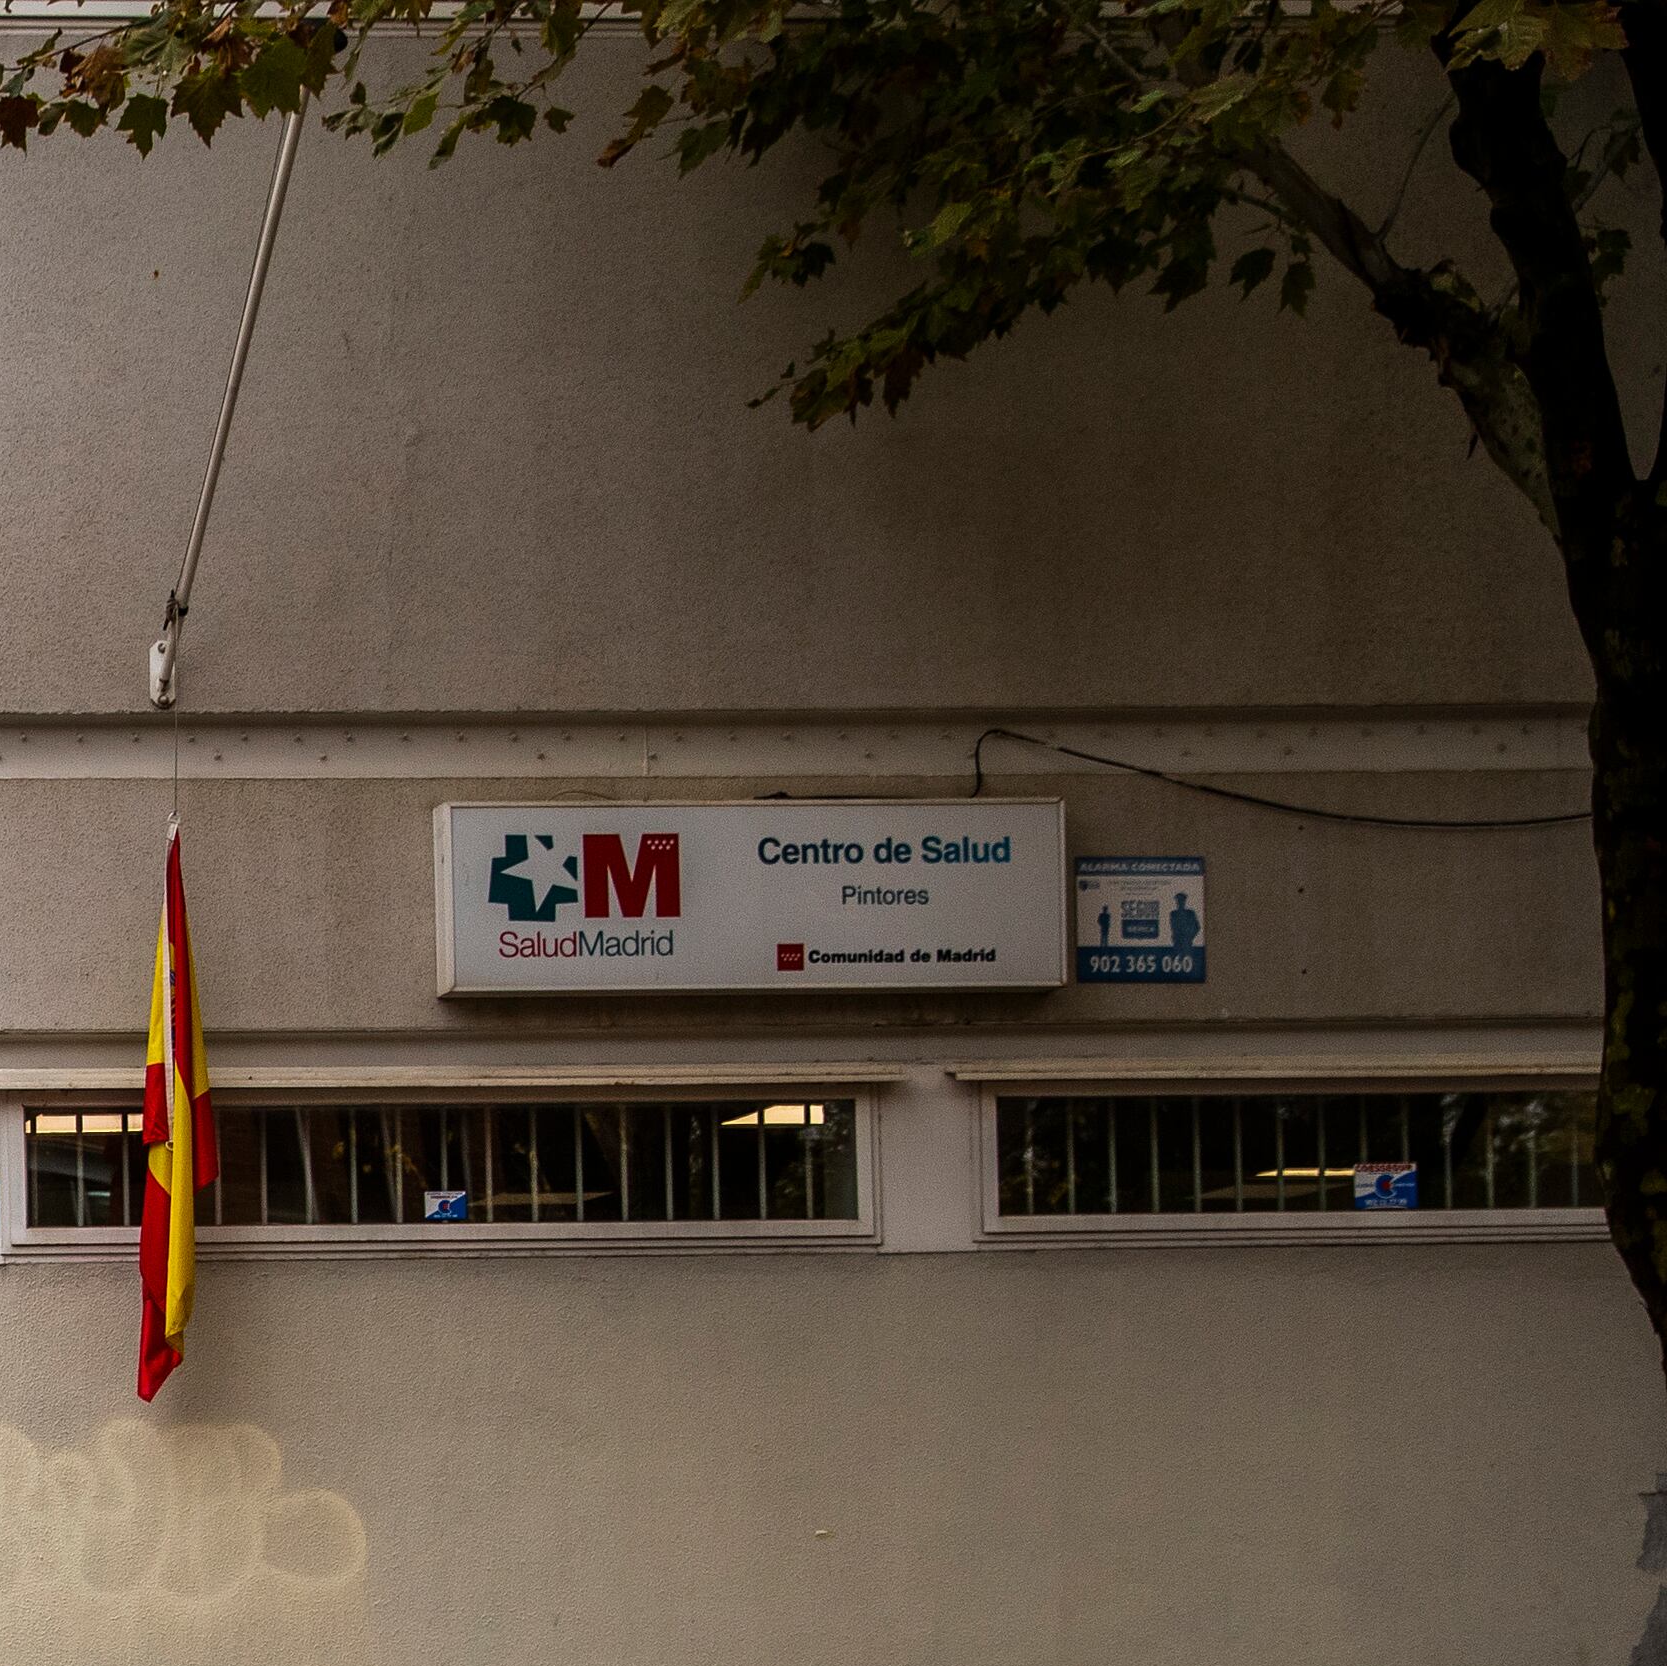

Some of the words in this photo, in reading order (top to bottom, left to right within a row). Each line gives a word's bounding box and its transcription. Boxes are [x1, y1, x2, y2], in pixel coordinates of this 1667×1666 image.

[758, 837, 864, 865] Centro
[874, 836, 912, 864] de
[921, 835, 1011, 864] Salud
[582, 833, 681, 919] M
[1079, 863, 1126, 872] ALARMA
[1130, 863, 1201, 872] CONECTADA
[841, 886, 929, 905] Pintores
[499, 930, 674, 958] SaludMadrid
[808, 949, 905, 964] Comunidad
[910, 949, 931, 963] de
[936, 948, 997, 963] Madrid
[1090, 955, 1121, 973] 902
[1125, 955, 1157, 973] 365
[1161, 955, 1194, 973] 060
